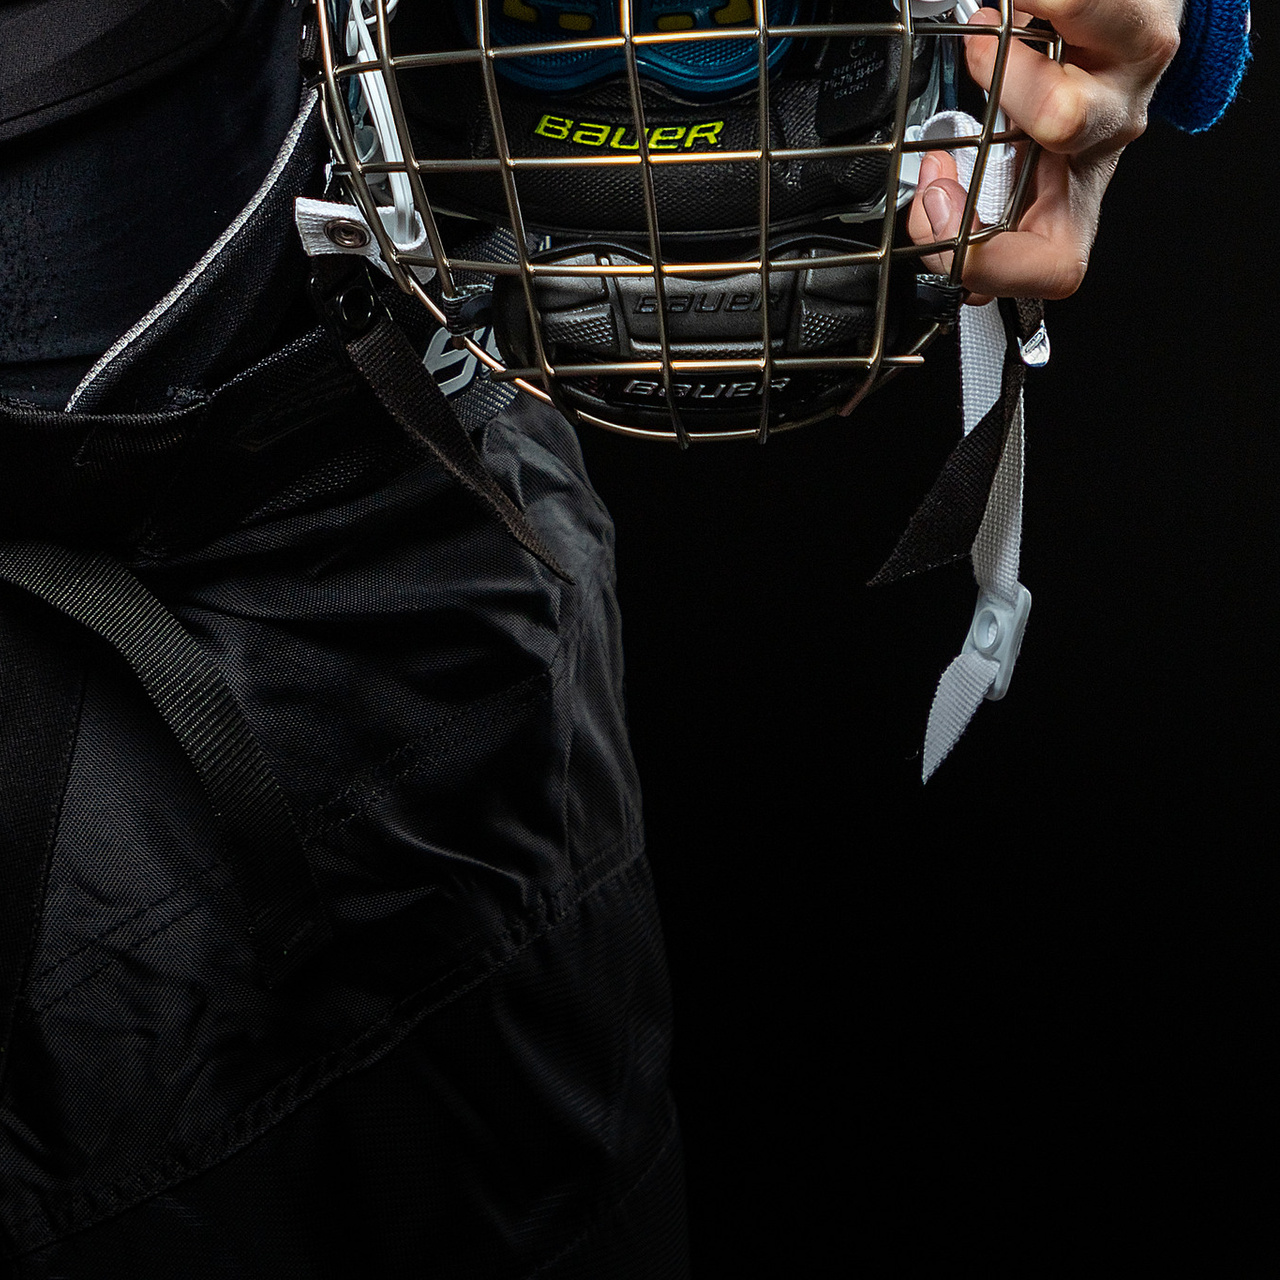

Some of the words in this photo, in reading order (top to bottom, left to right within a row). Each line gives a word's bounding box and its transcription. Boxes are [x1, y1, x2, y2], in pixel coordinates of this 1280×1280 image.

[534, 114, 725, 150] BAUER
[633, 291, 783, 315] BAUER
[623, 377, 792, 399] BAUER
